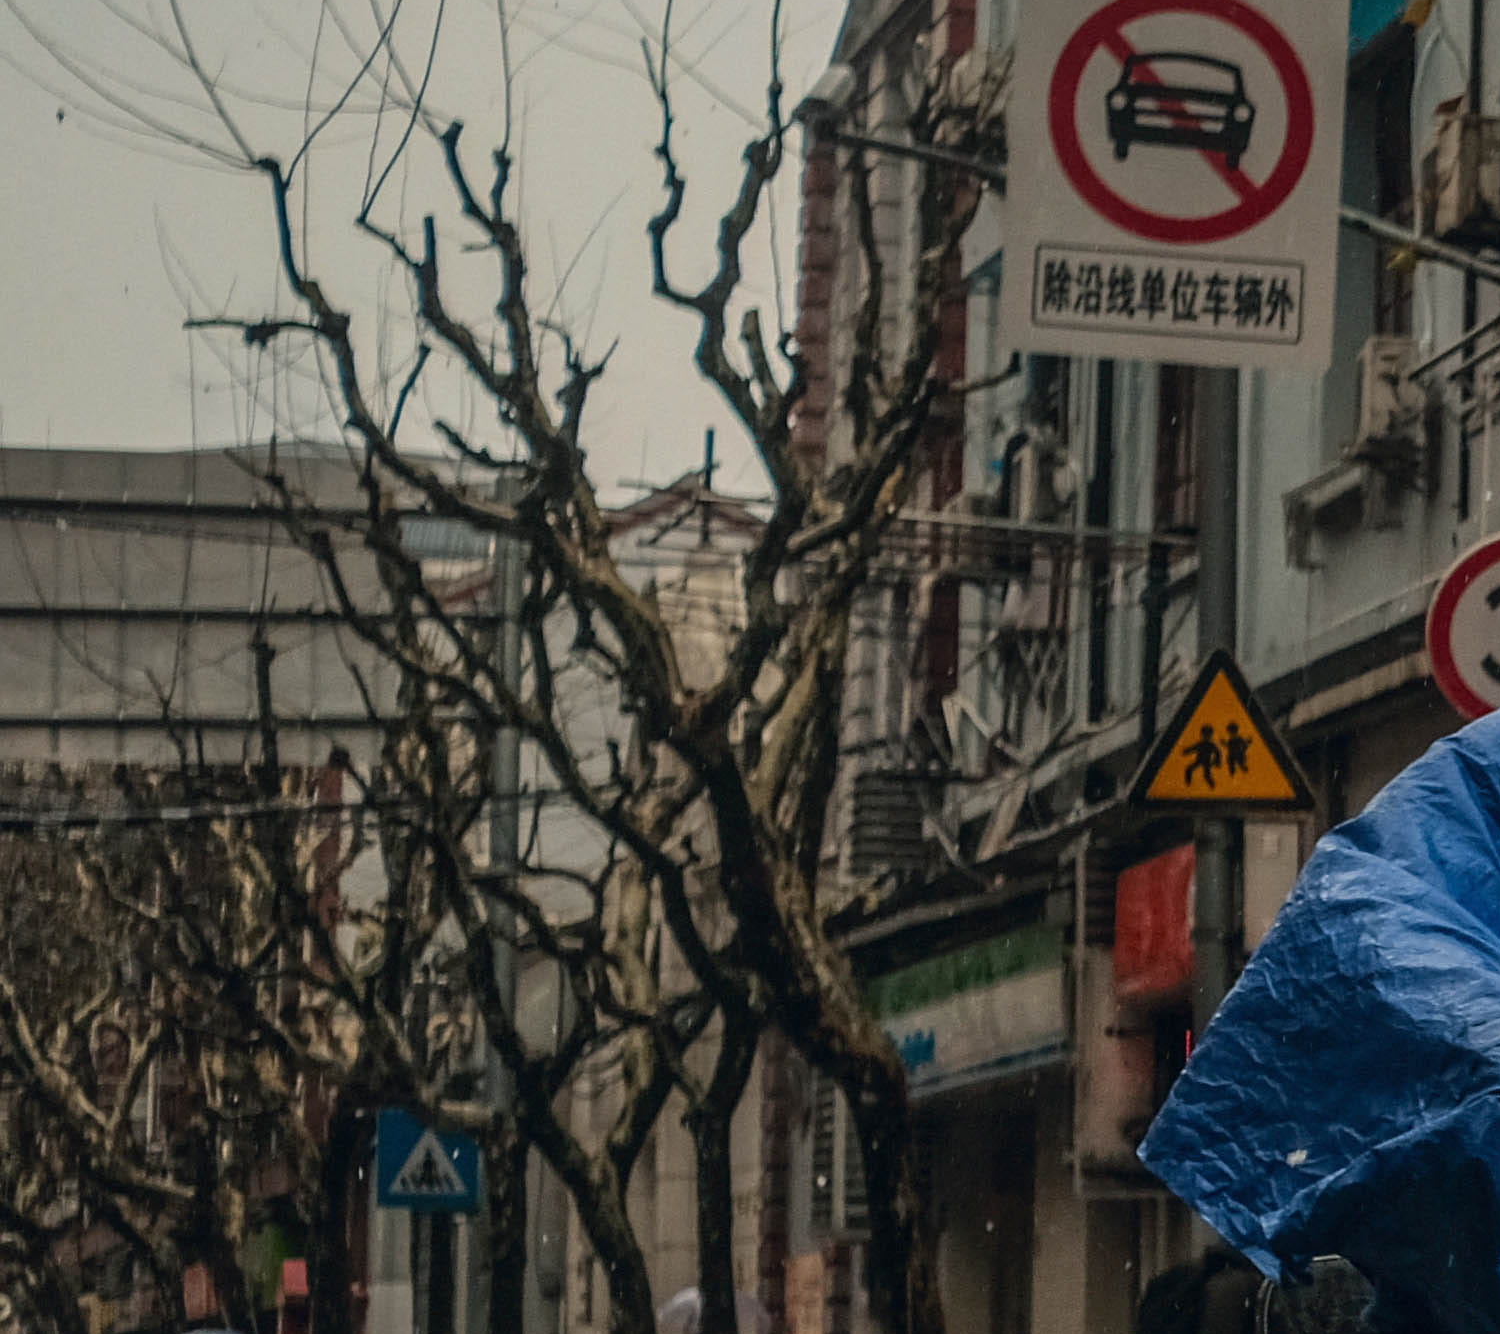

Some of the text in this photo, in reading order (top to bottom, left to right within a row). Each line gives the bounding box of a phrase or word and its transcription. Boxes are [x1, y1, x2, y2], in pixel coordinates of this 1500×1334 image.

[1042, 260, 1294, 330] 除沿线单位车辆外
